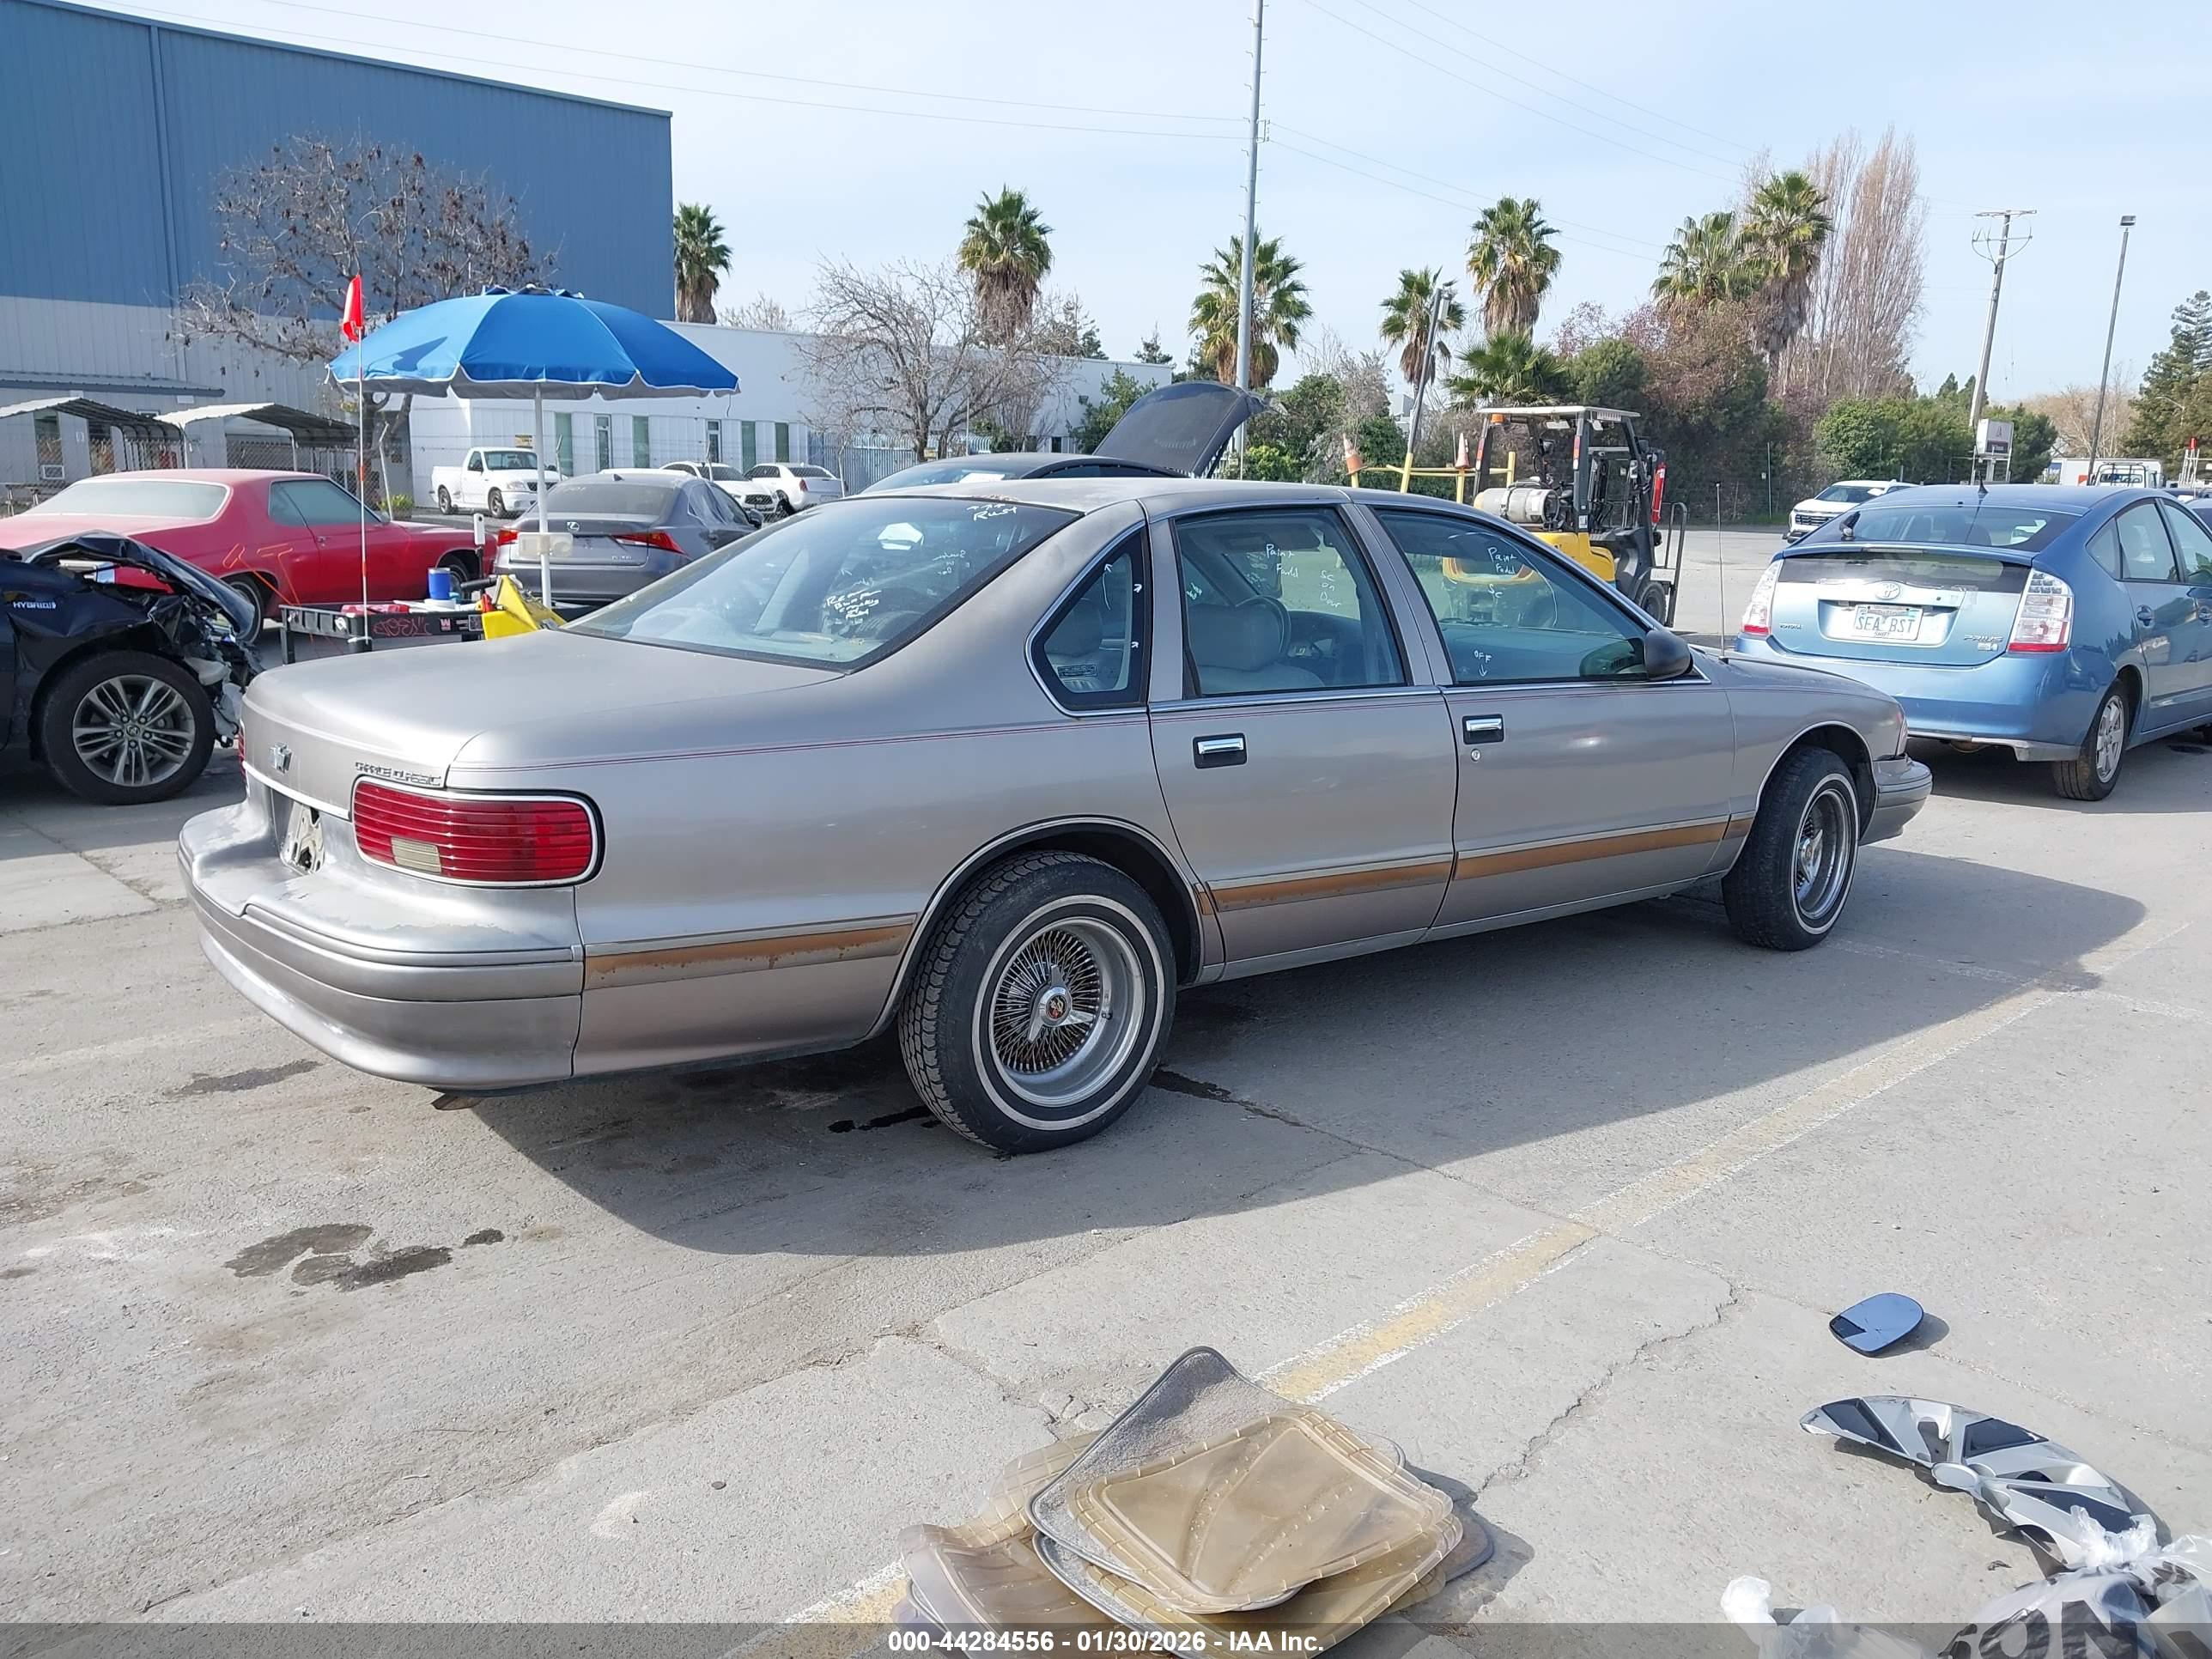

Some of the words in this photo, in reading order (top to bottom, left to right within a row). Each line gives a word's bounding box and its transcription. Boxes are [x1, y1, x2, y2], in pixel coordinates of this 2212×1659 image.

[1486, 547, 1517, 563] Paint
[1856, 616, 1881, 631] SEA
[1889, 617, 1916, 634] BST
[1964, 634, 2003, 643] PRIUS
